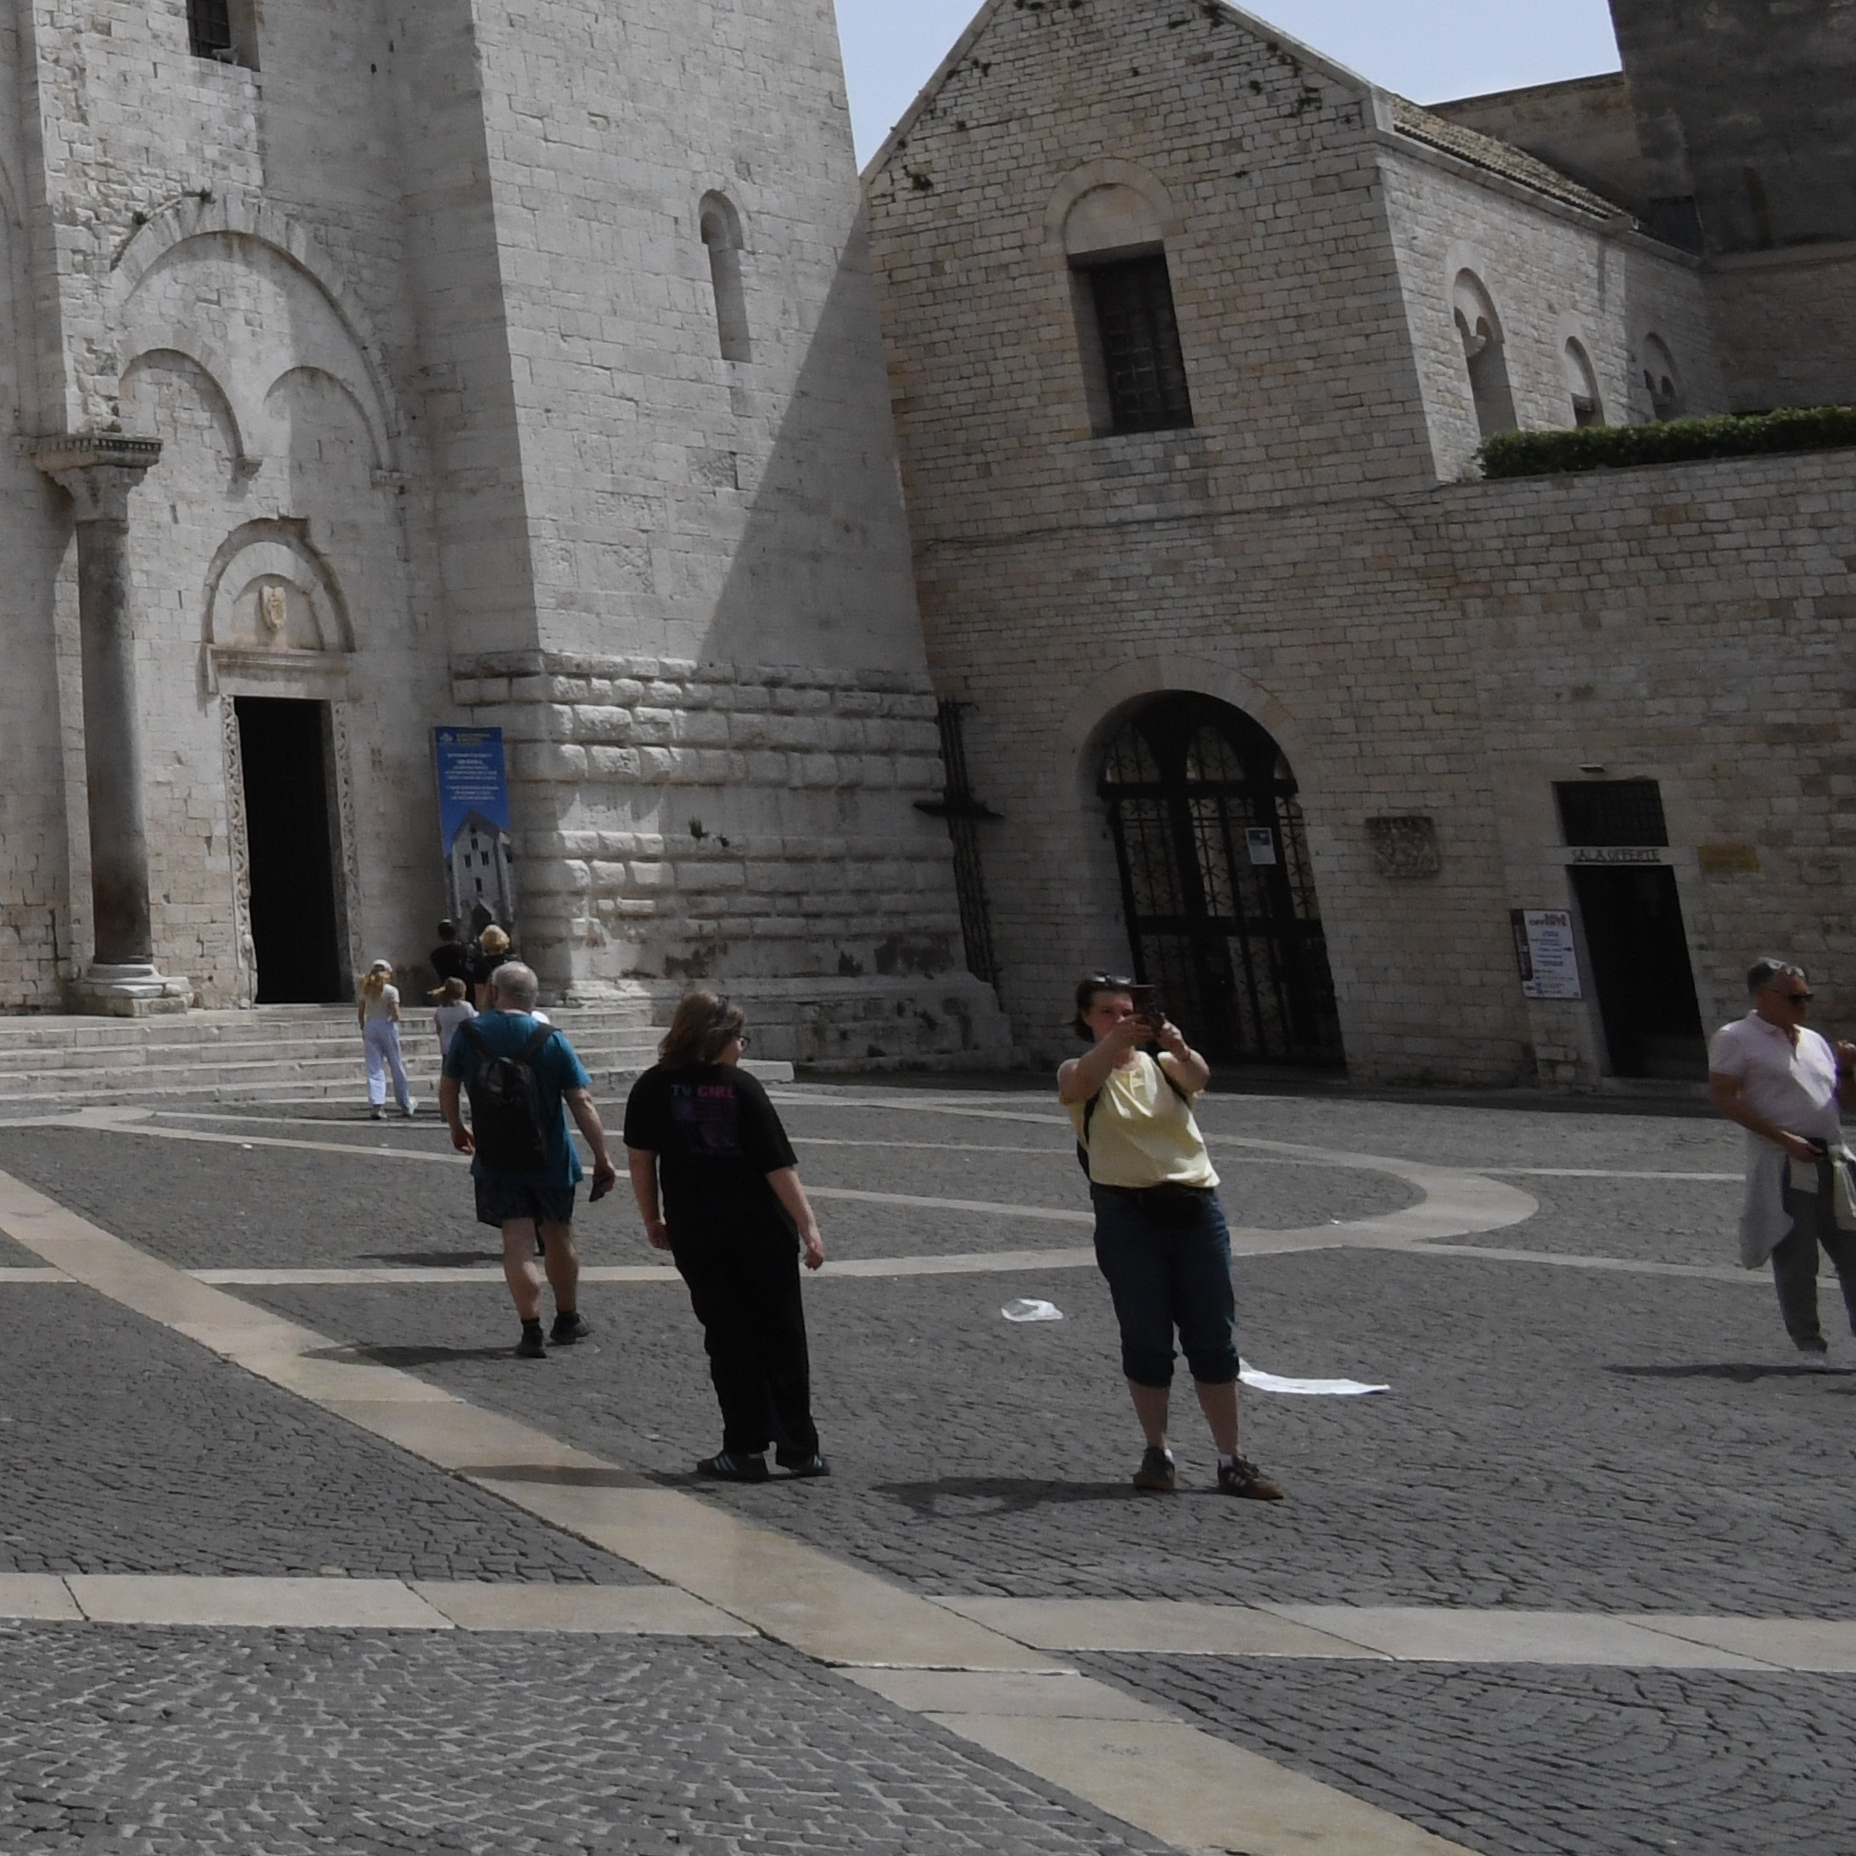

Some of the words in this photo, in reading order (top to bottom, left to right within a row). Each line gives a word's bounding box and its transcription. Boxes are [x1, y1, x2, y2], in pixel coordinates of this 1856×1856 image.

[1572, 848, 1606, 861] SALA
[1607, 848, 1659, 861] OFFERTE
[670, 1084, 692, 1097] TV
[697, 1085, 736, 1098] GIRL
